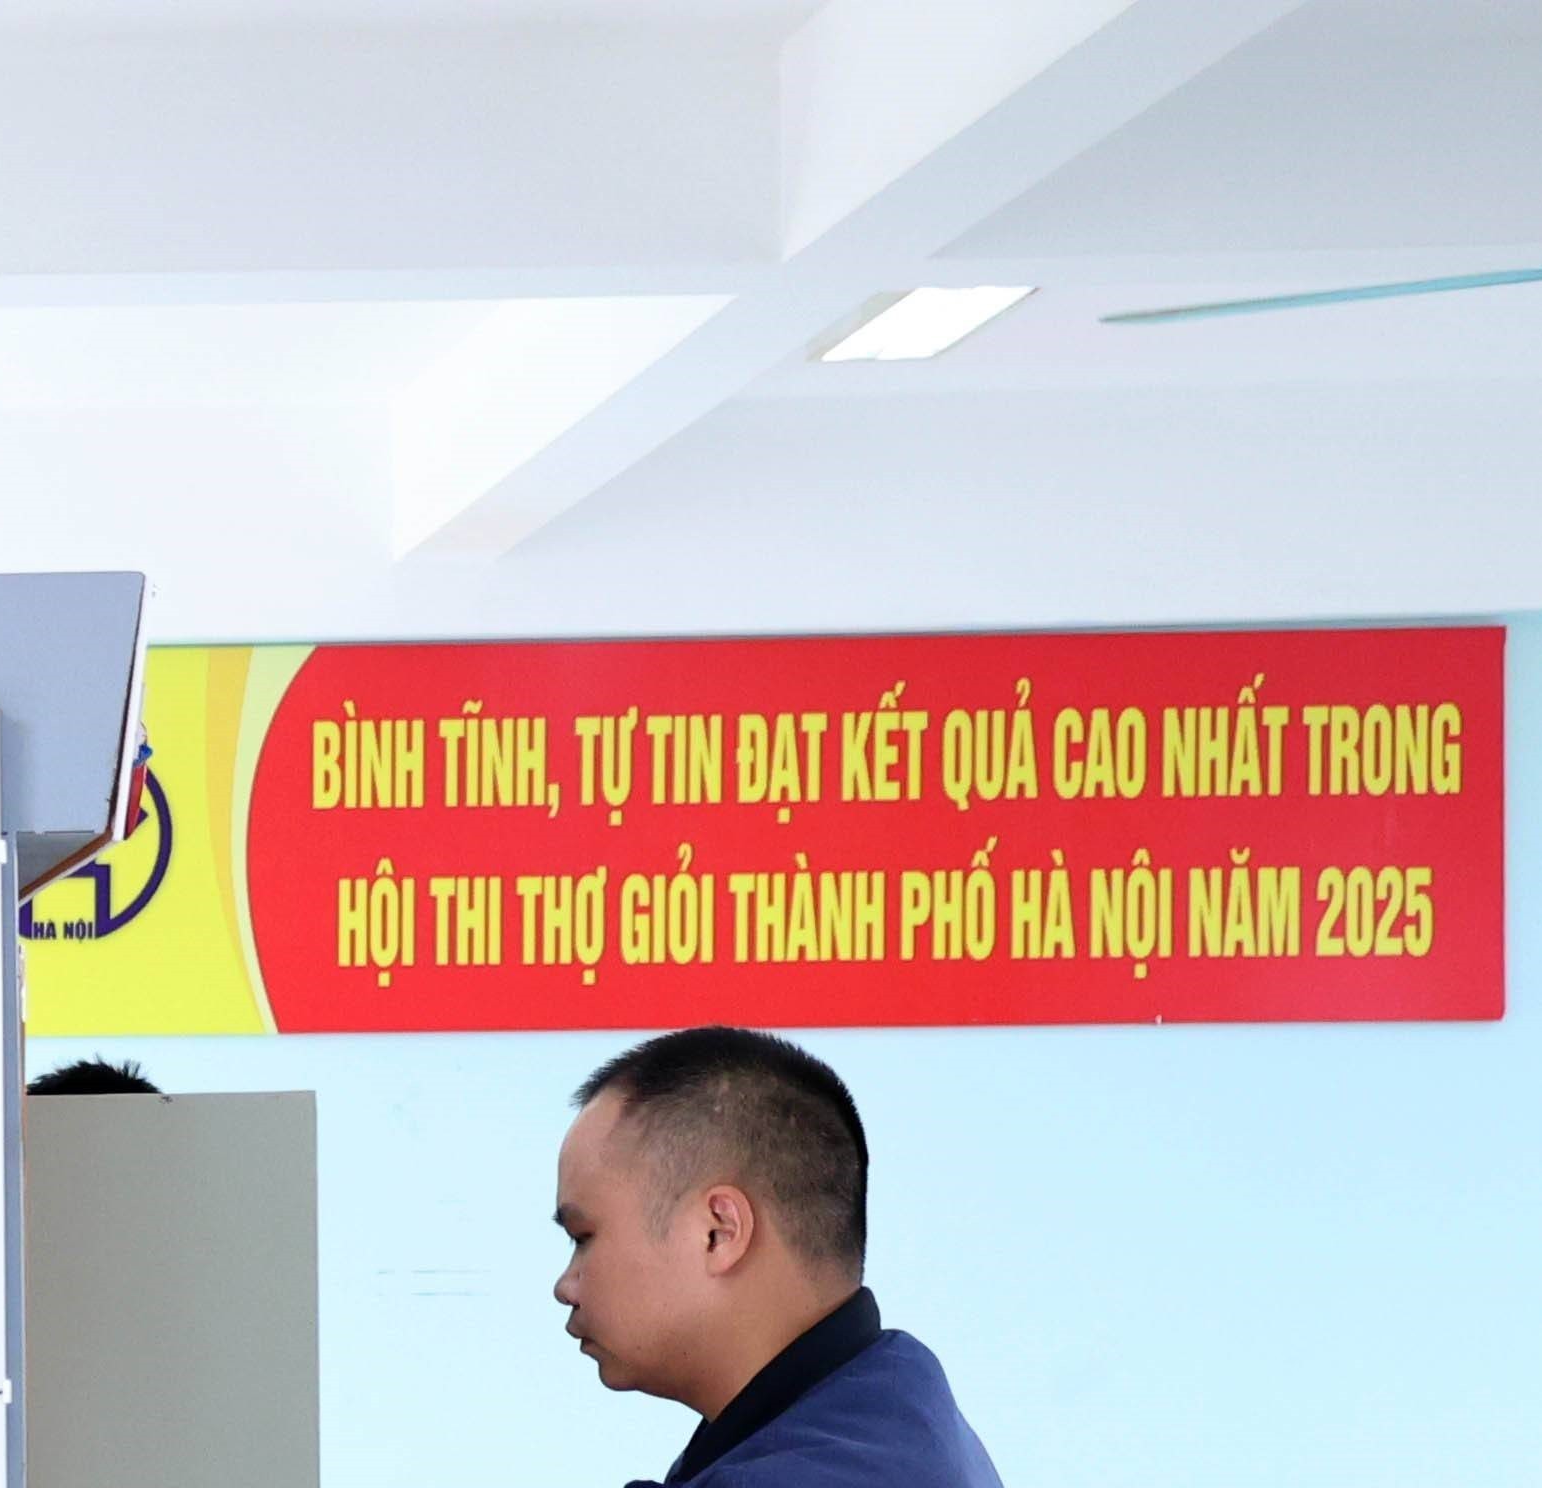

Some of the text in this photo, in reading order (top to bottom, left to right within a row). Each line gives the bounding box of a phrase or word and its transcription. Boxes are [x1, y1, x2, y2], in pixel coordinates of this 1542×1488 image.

[312, 673, 1461, 826] BÌNH TĨNH, TỰ TIN ĐẠT KẾT QUẢ CAO NHẤT TRONG
[33, 918, 93, 944] HÀ NỘI
[338, 836, 1433, 987] HỘI THI THỢ GIỎI THÀNH PHỐ HÀ NỘI NĂM 2025
